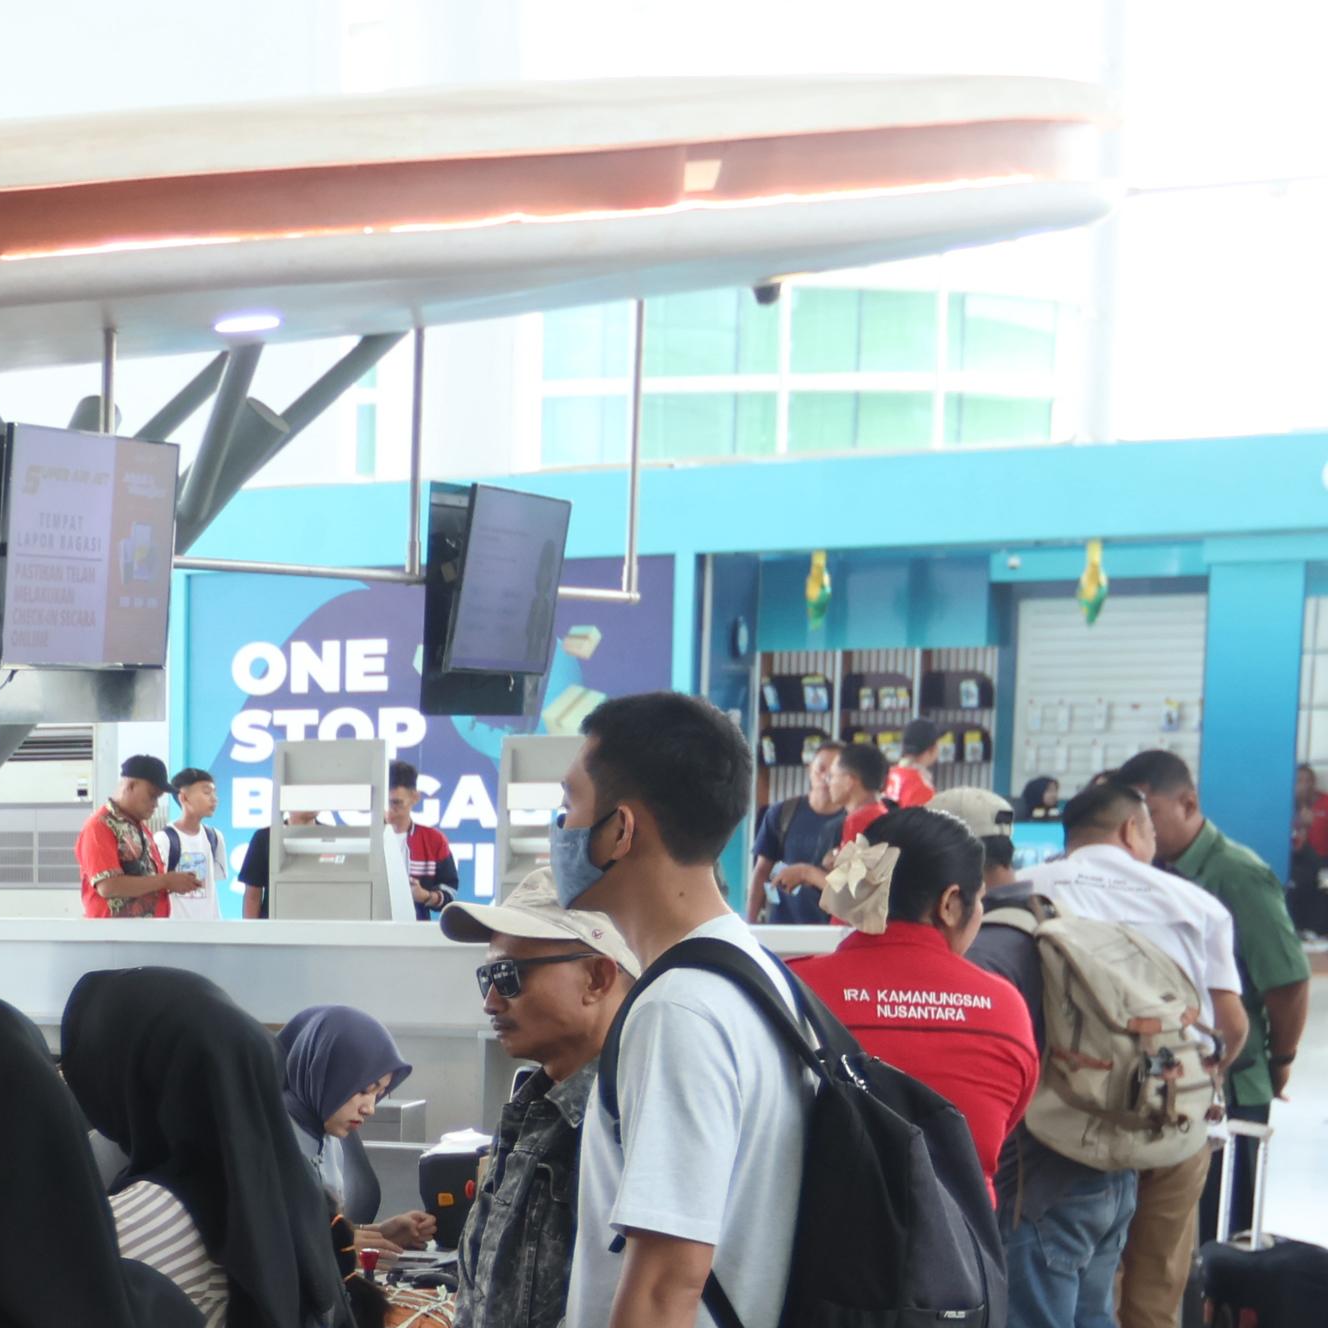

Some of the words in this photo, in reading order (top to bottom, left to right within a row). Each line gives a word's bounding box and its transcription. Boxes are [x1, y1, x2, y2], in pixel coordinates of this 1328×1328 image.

[231, 638, 390, 696] ONE
[229, 706, 428, 764] STOP
[876, 1004, 967, 1022] NUSANTARA
[877, 989, 992, 1010] KAMANUNGSAN
